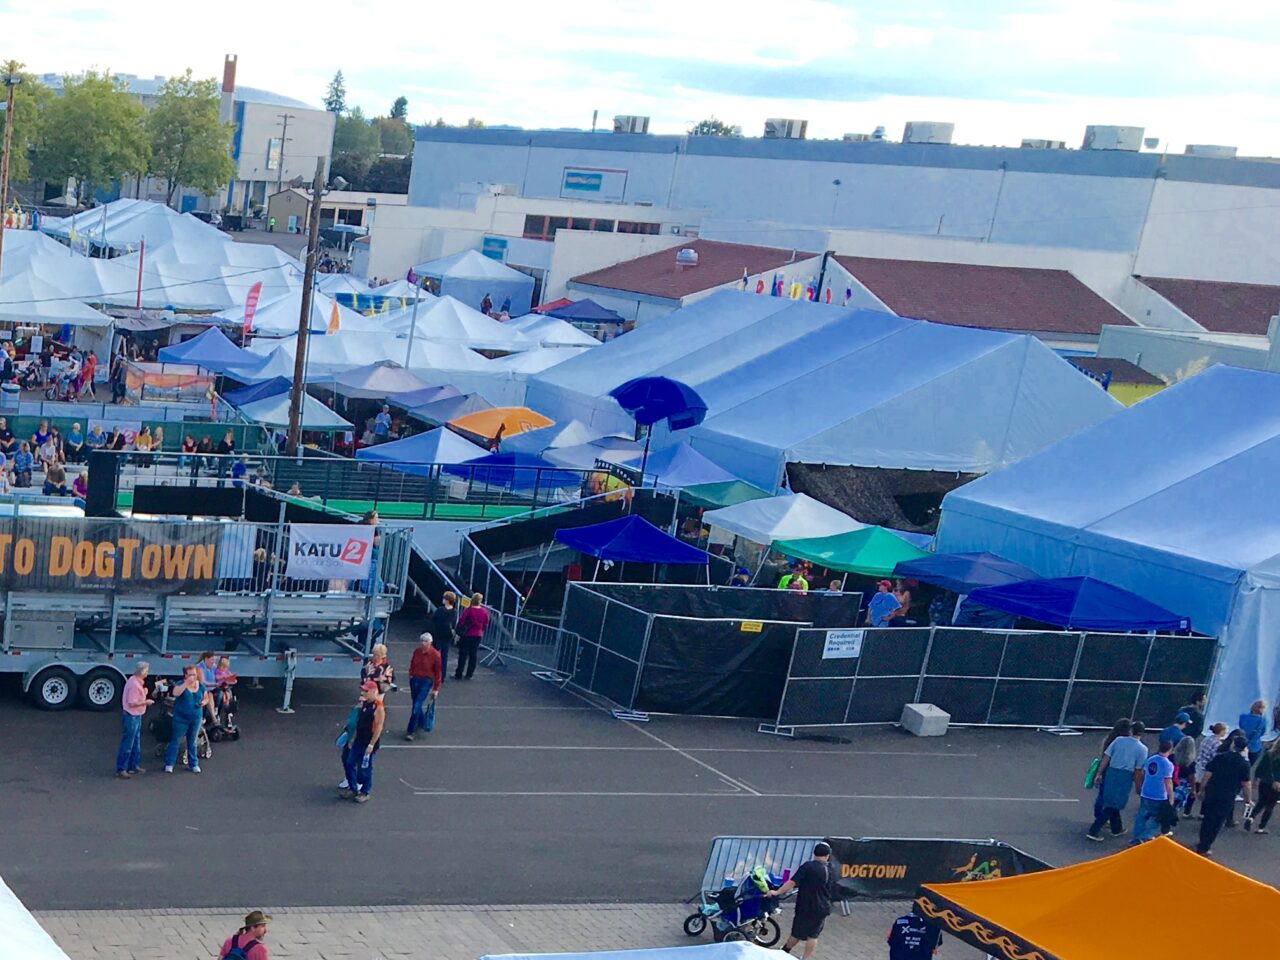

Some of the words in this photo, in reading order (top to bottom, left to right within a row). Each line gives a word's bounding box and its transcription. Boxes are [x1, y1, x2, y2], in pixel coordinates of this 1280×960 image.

[48, 535, 215, 580] DOGTOWN
[294, 542, 342, 557] KATU
[344, 541, 362, 560] 2
[829, 632, 861, 640] Credential
[841, 863, 907, 879] DOGTOWN
